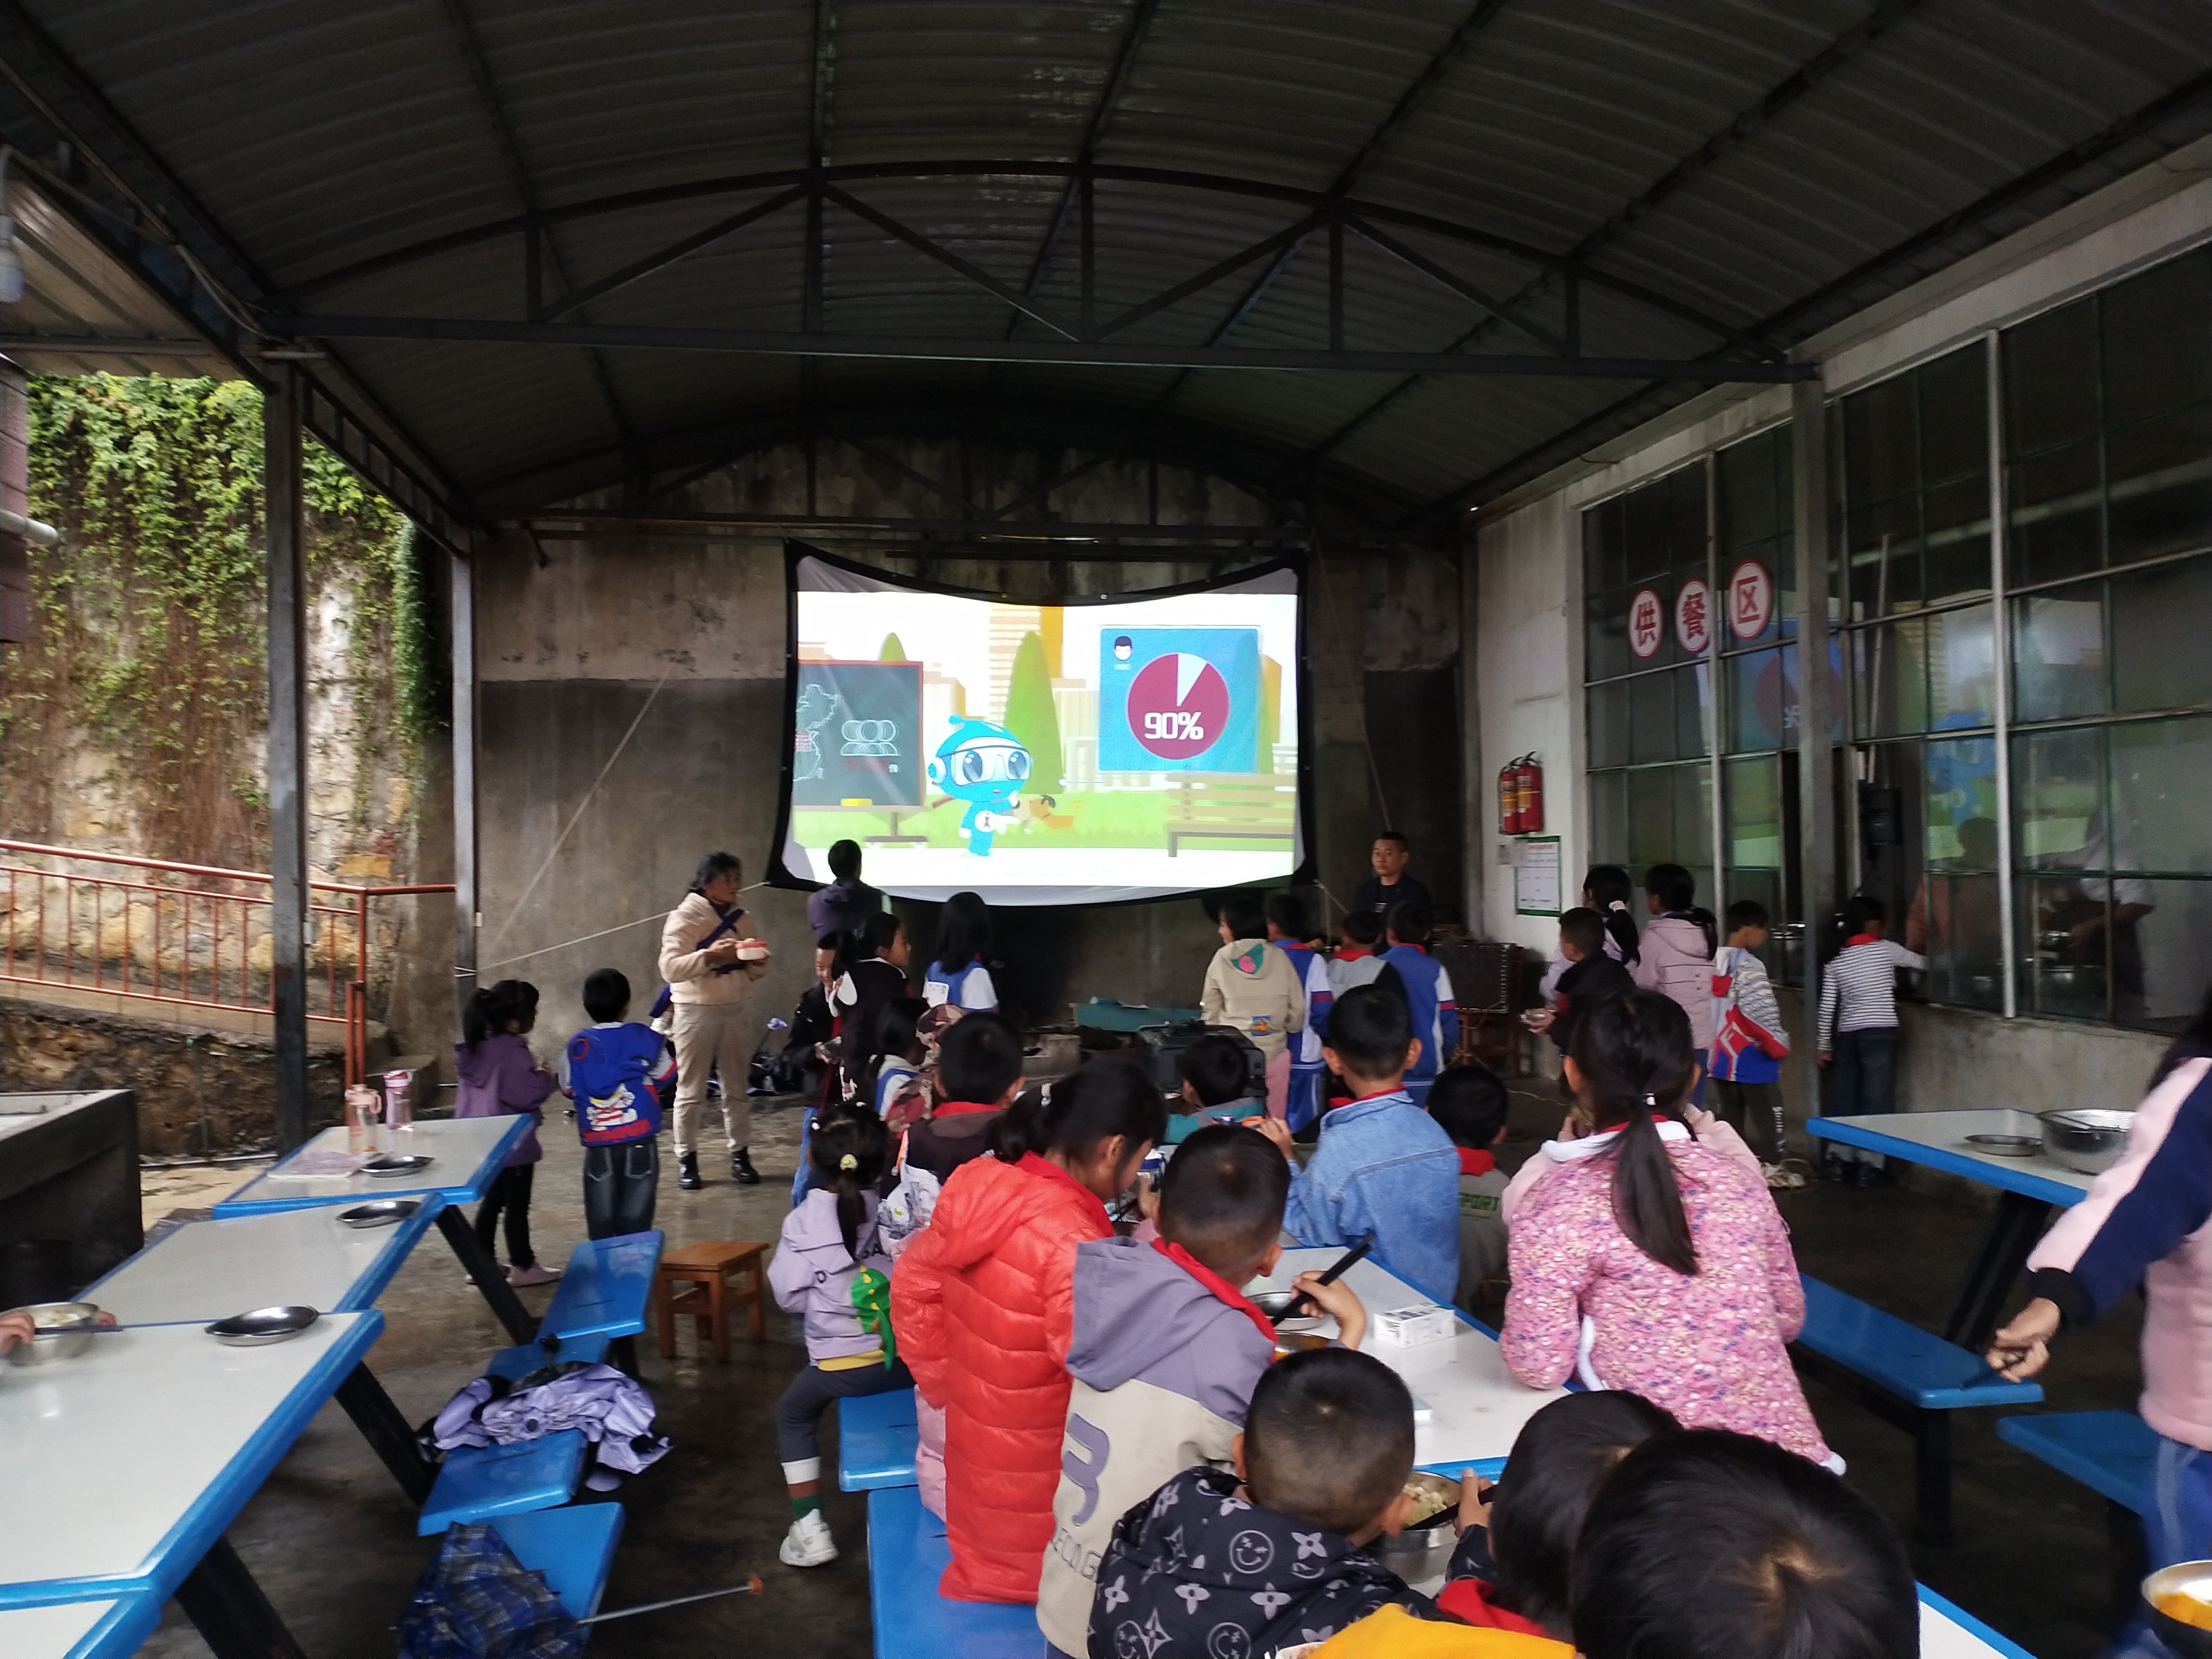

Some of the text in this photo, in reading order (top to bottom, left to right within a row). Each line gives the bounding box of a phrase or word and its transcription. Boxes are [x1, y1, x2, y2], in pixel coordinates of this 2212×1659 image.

[1635, 575, 1761, 647] 供餐区
[1144, 712, 1204, 740] 90%
